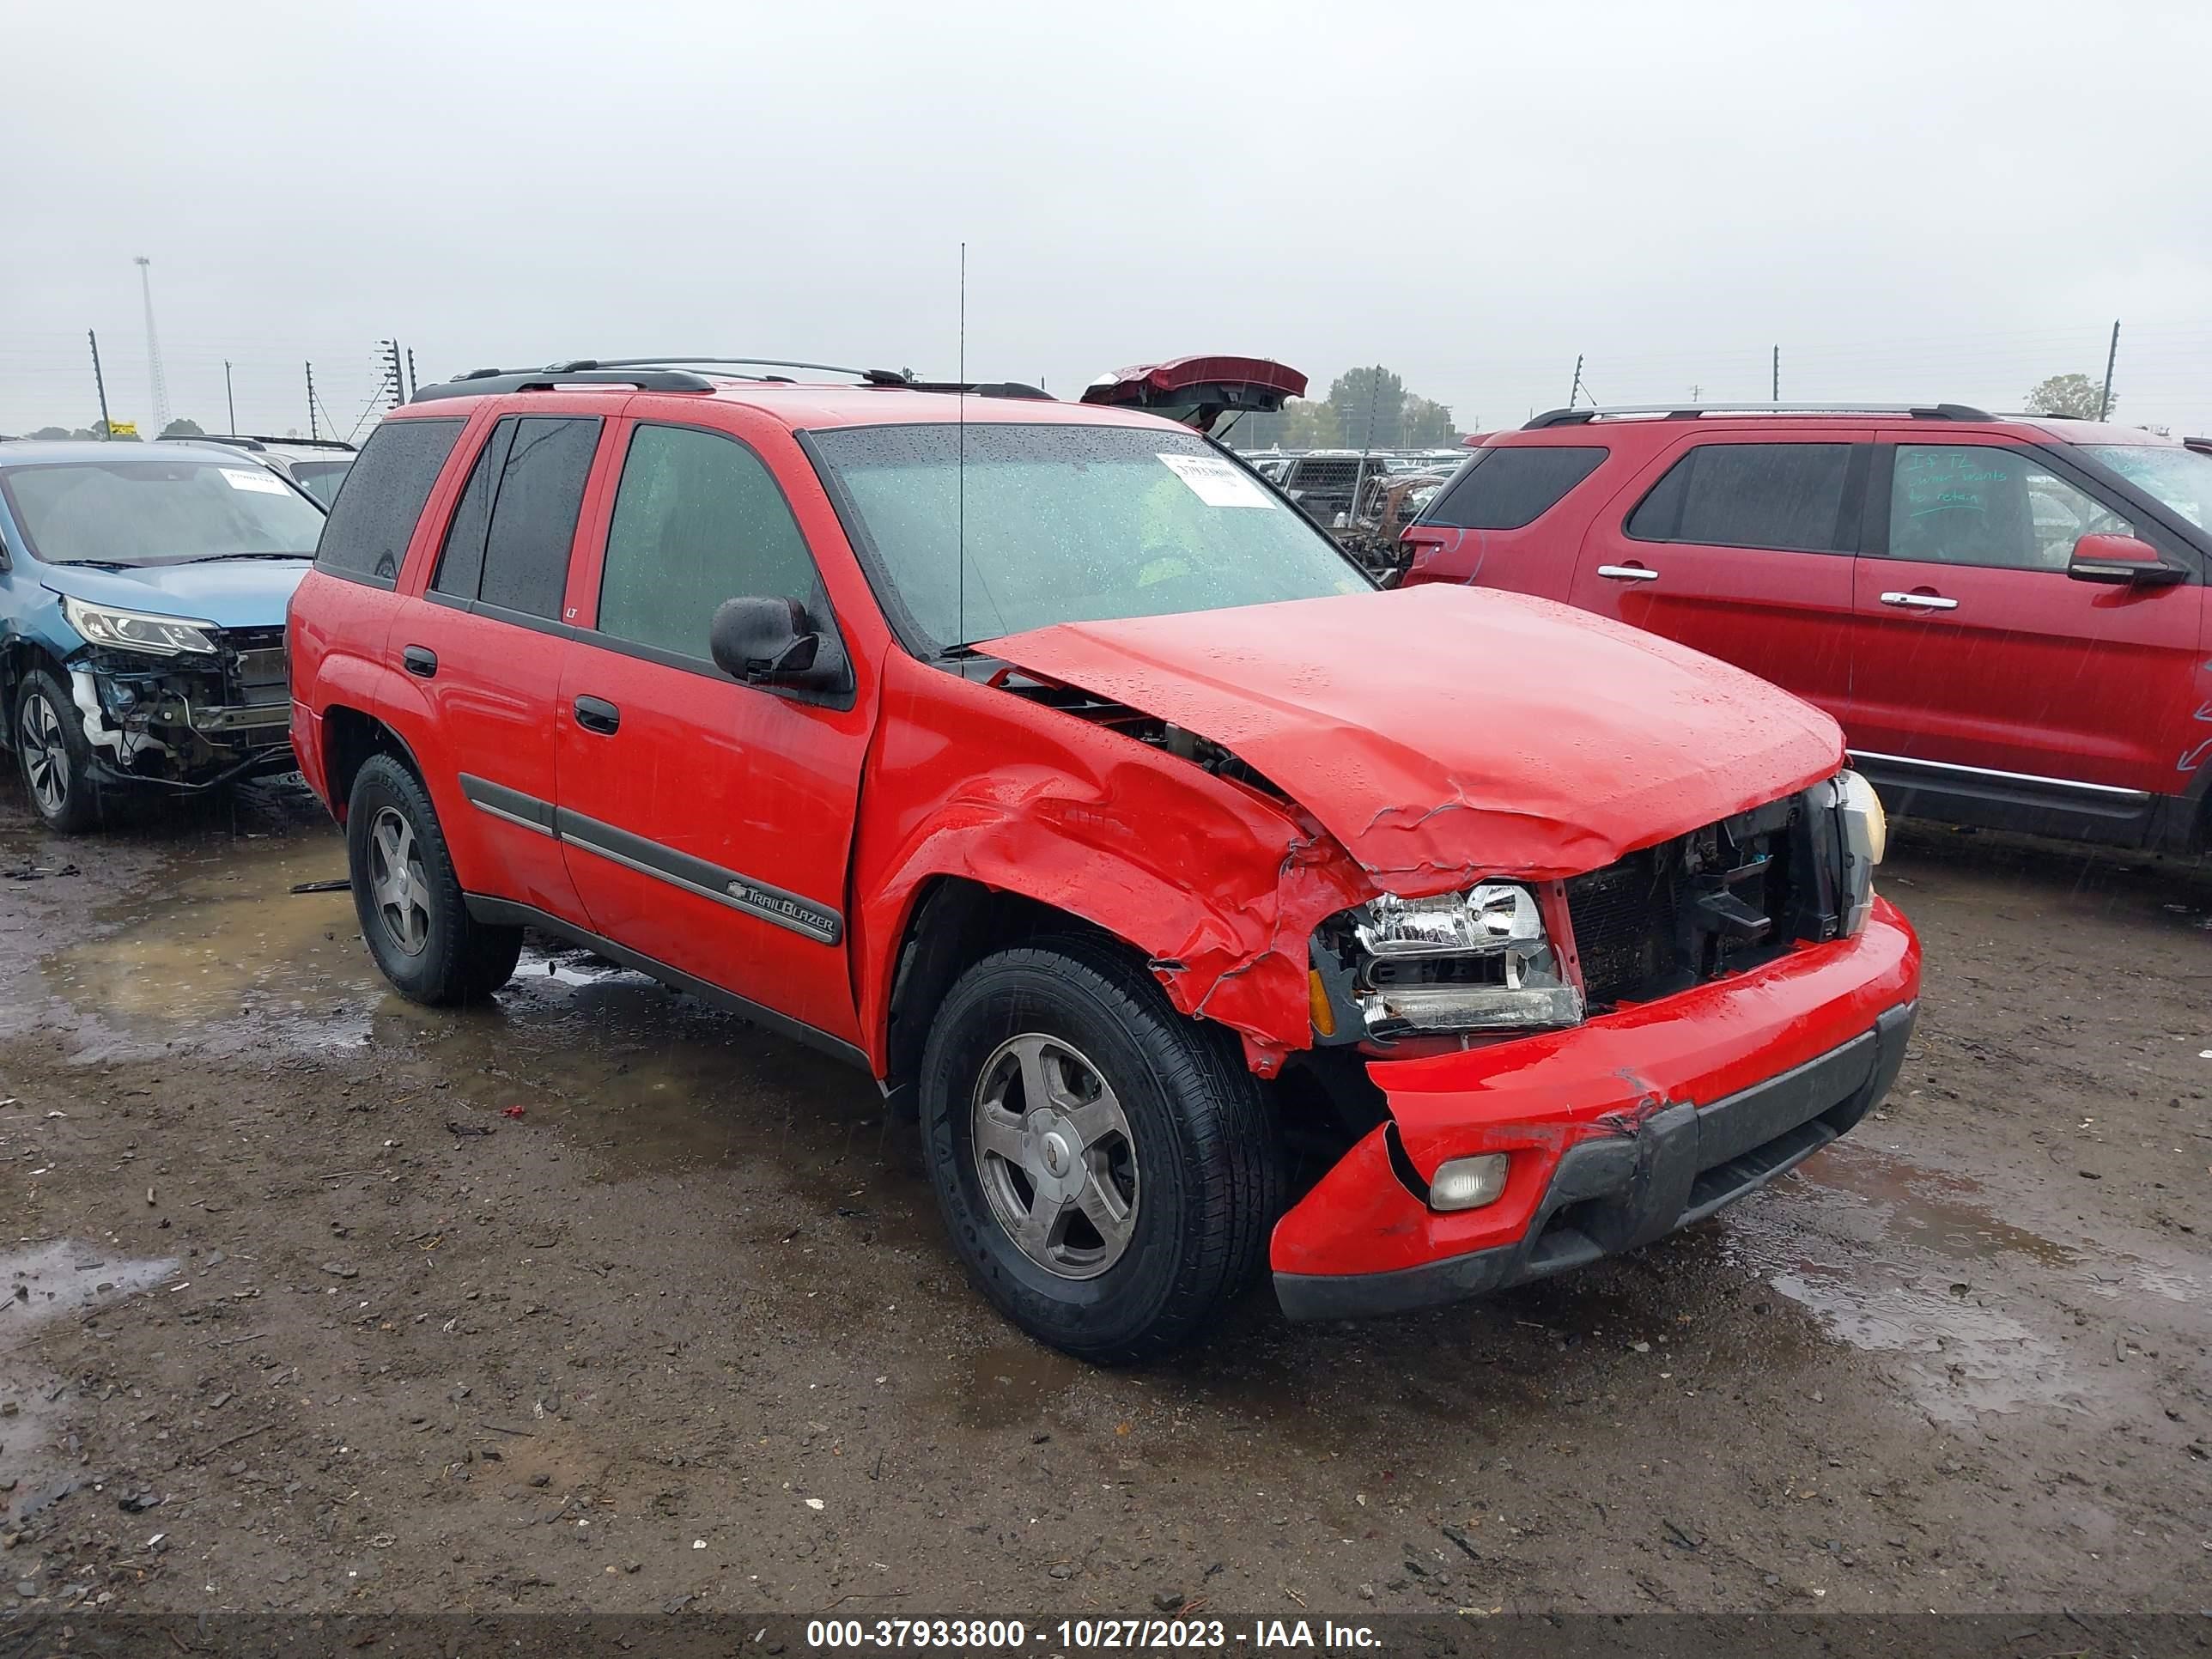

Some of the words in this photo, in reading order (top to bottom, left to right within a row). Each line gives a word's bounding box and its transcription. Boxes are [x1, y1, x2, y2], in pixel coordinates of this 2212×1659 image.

[1963, 470, 2007, 482] wants
[1936, 489, 1978, 503] retain
[567, 607, 578, 618] LT
